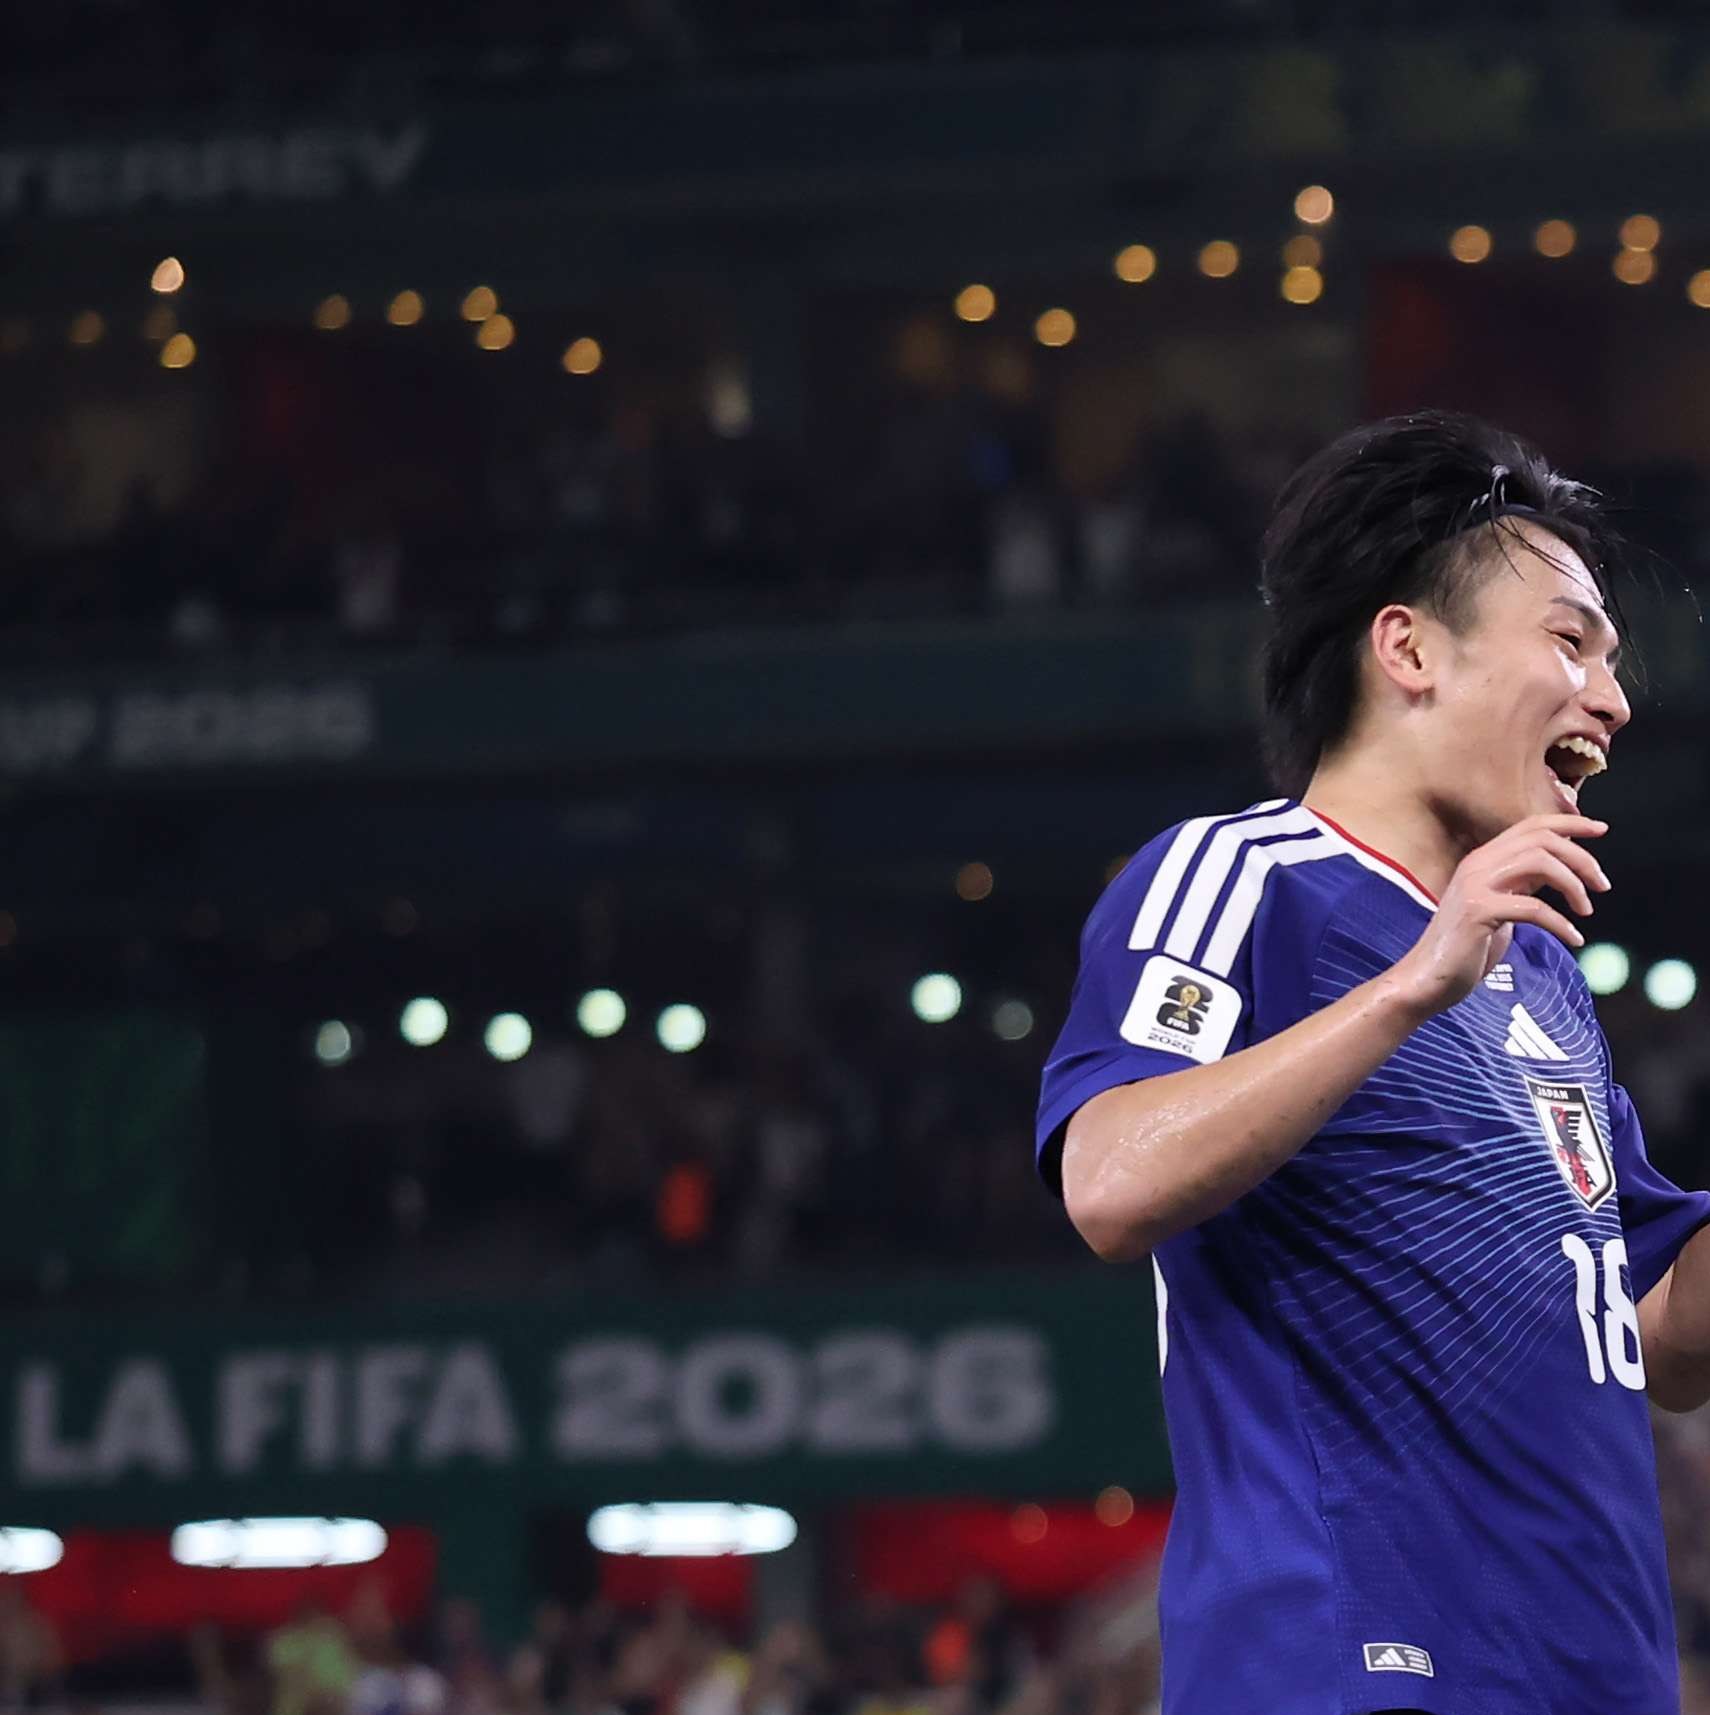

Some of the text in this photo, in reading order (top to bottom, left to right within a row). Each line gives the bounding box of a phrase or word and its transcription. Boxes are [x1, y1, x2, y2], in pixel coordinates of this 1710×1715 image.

[1536, 1086, 1569, 1100] JAPAN
[1561, 1233, 1646, 1390] 18
[14, 1326, 1056, 1484] LA FIFA 2026
